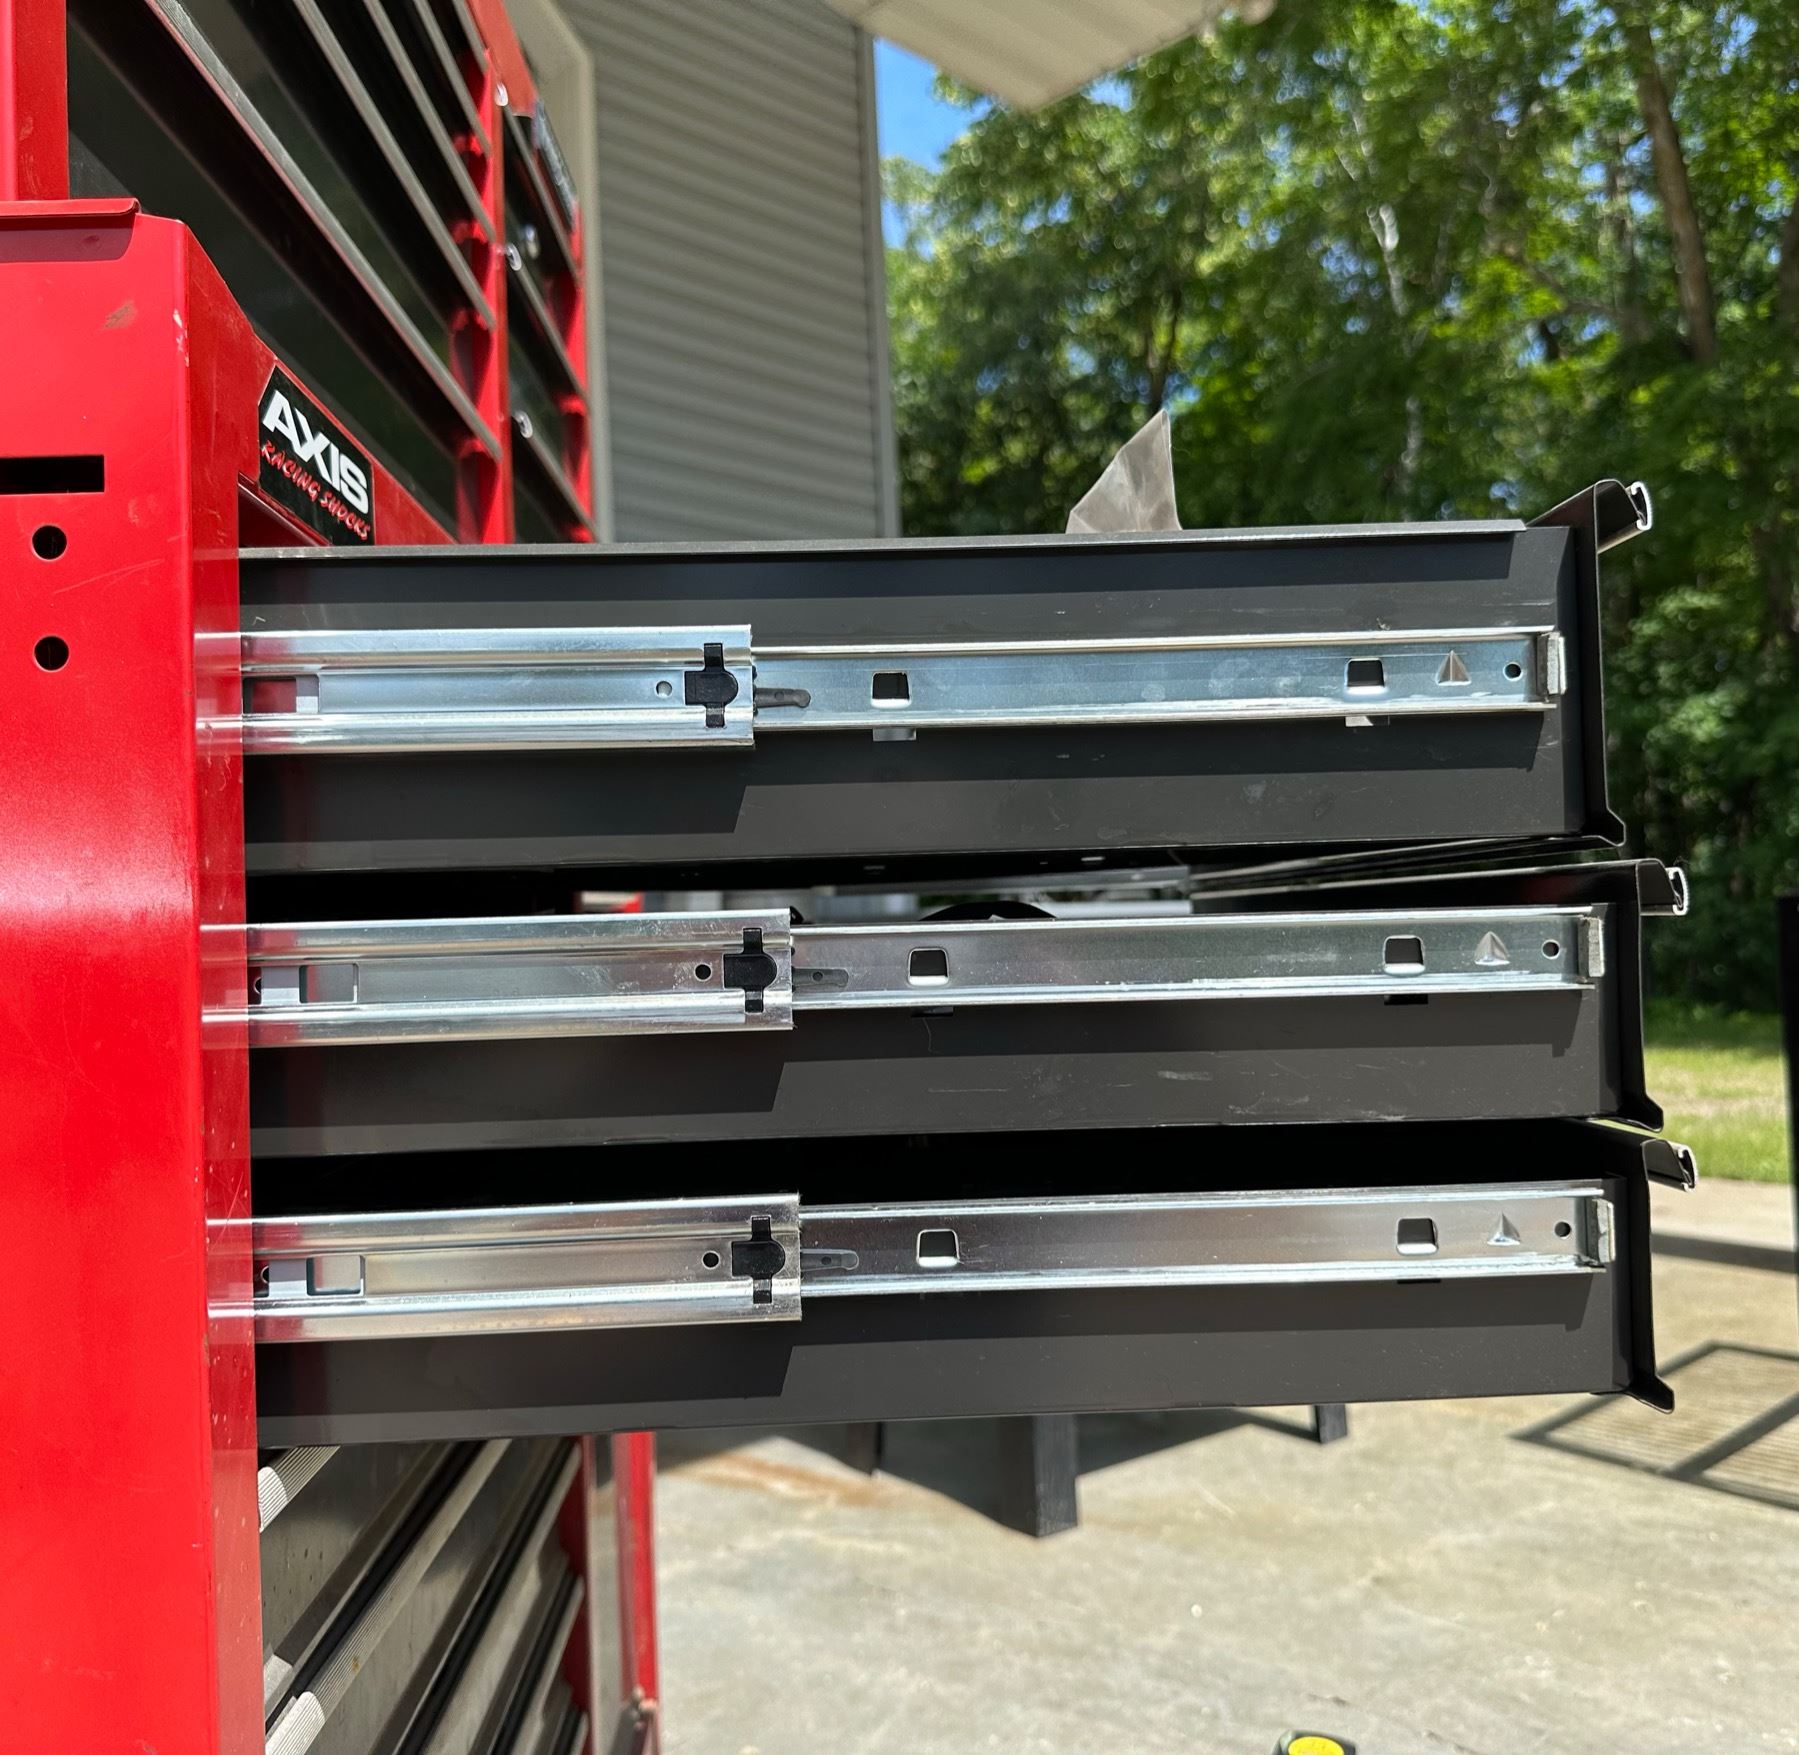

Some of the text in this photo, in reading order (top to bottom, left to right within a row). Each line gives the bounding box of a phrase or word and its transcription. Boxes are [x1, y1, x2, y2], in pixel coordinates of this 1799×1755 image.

[261, 440, 370, 540] RACING SHOCKS
[262, 390, 368, 514] AXIS
